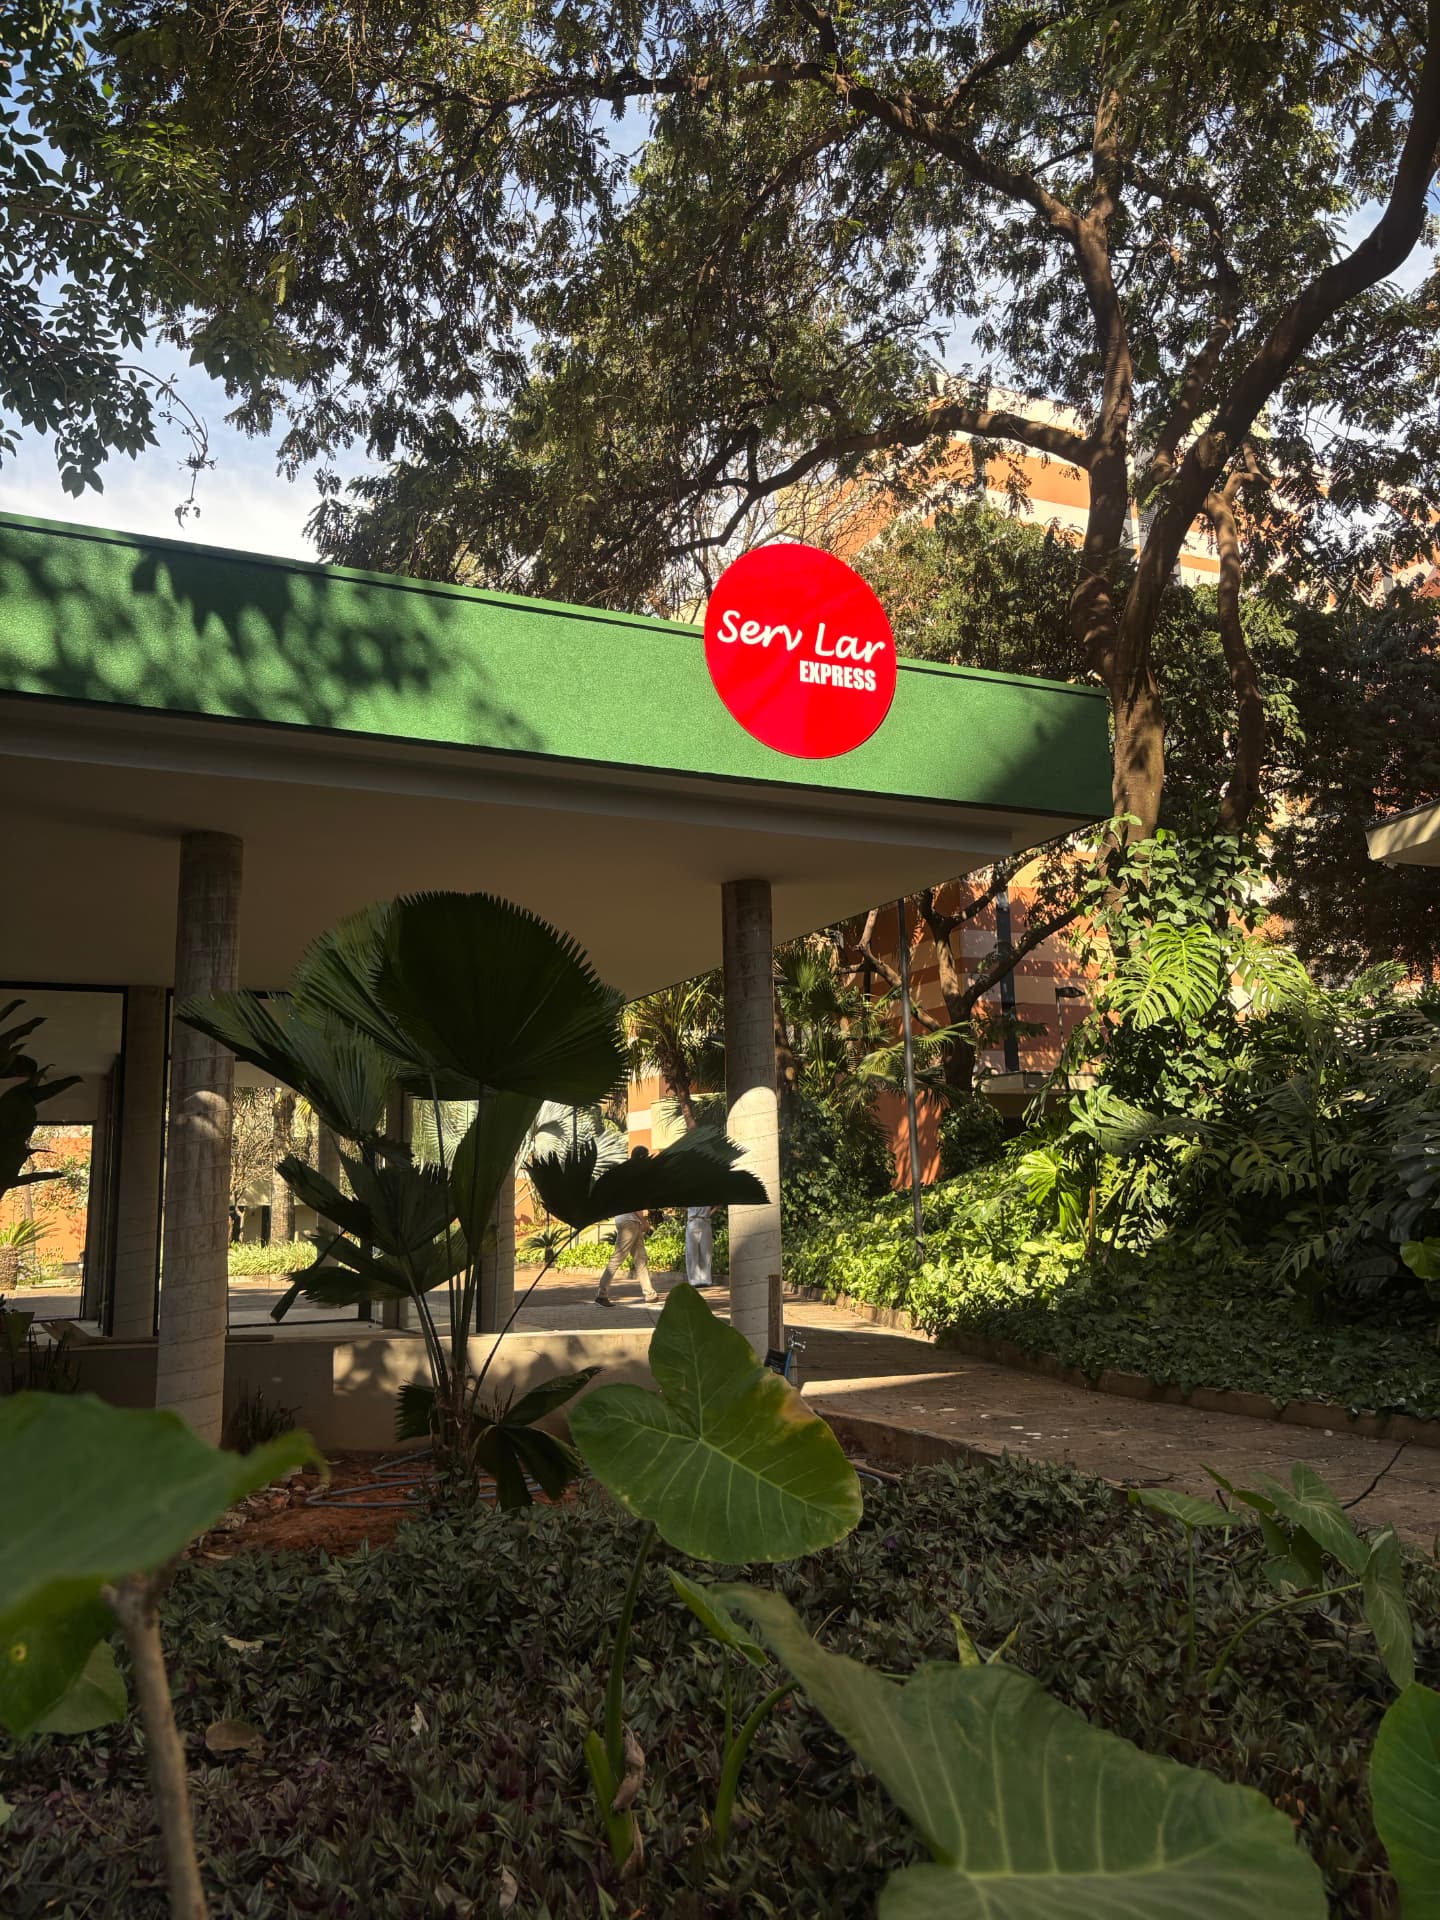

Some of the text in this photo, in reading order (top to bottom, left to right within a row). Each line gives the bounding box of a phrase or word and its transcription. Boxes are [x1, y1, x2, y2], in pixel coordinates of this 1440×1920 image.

[717, 609, 886, 663] Serv Lar
[799, 659, 877, 692] EXPRESS
